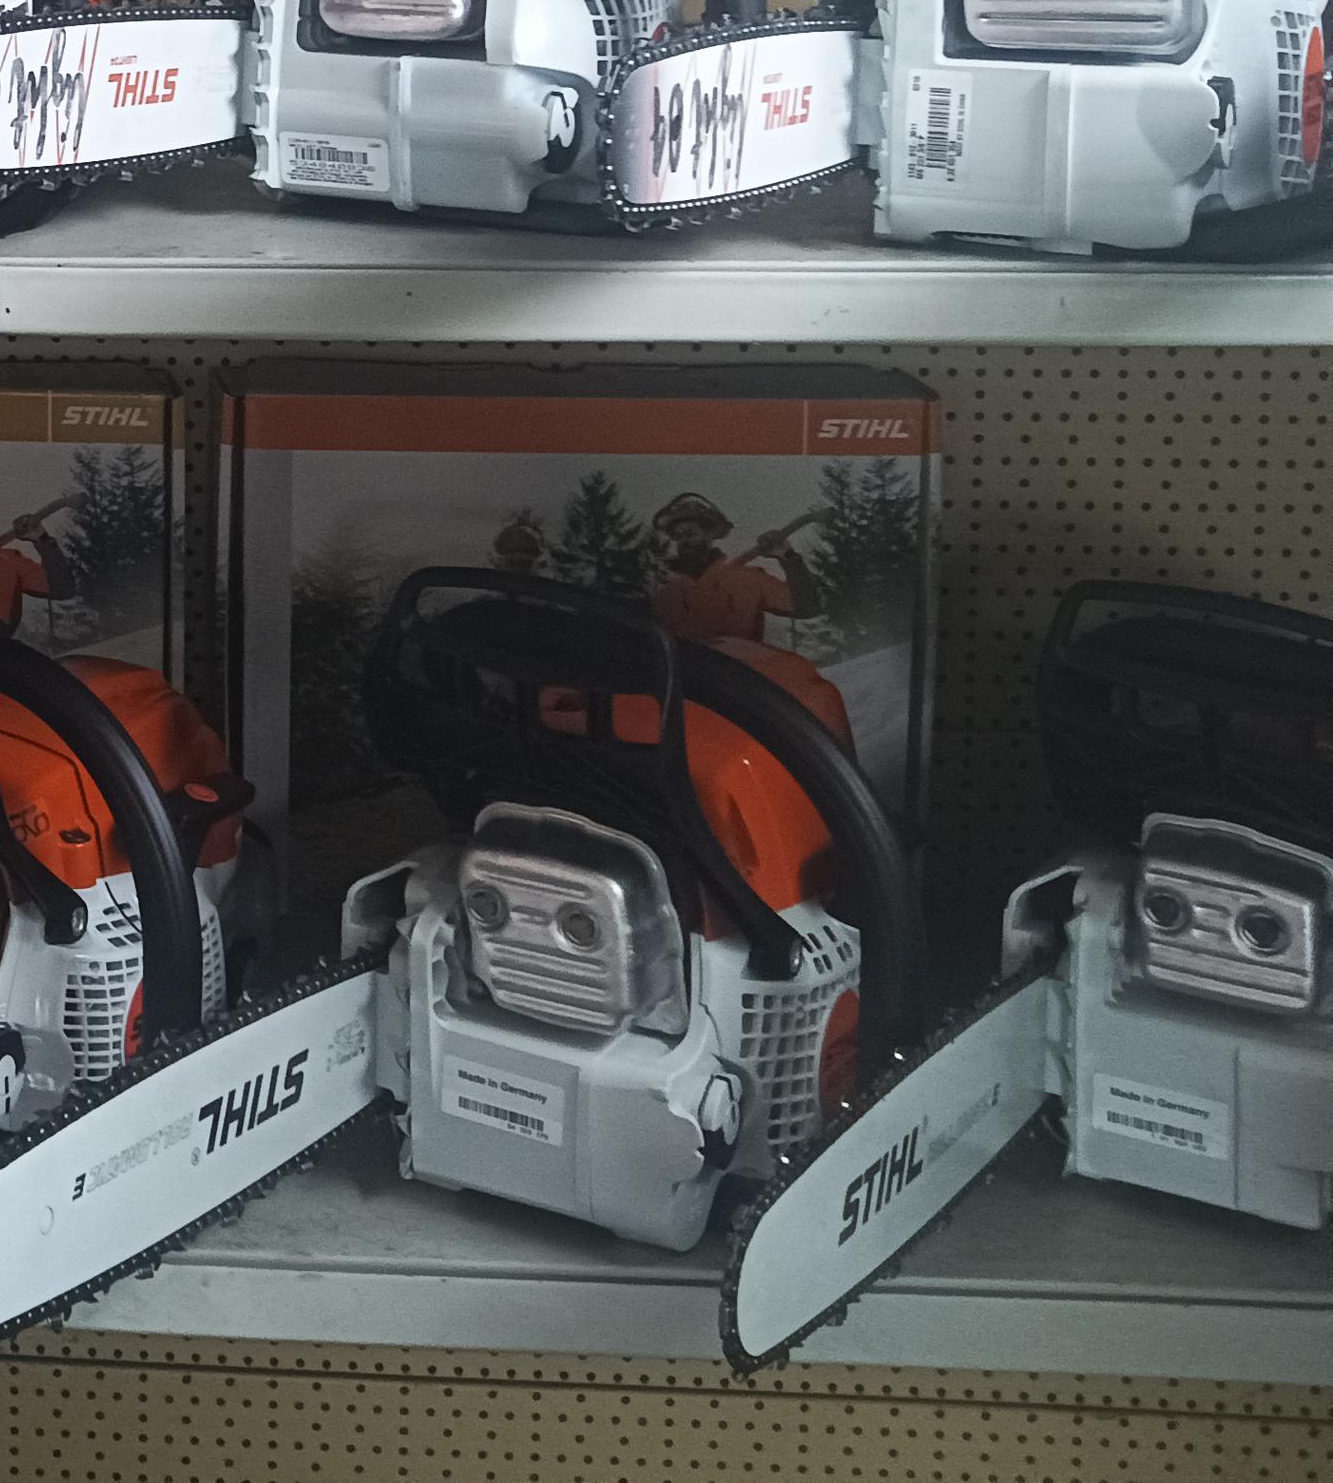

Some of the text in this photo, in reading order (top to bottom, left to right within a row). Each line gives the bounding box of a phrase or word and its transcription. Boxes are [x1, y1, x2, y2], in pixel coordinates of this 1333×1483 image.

[108, 68, 179, 108] STIHL
[761, 85, 813, 131] STIHL
[59, 404, 150, 428] STIHL
[817, 417, 911, 440] STIHL
[198, 1048, 310, 1155] STIHL
[458, 1069, 547, 1105] Made in Germany
[1110, 1086, 1210, 1120] Made in Germany
[72, 1173, 87, 1202] E
[838, 1124, 924, 1247] STIHL
